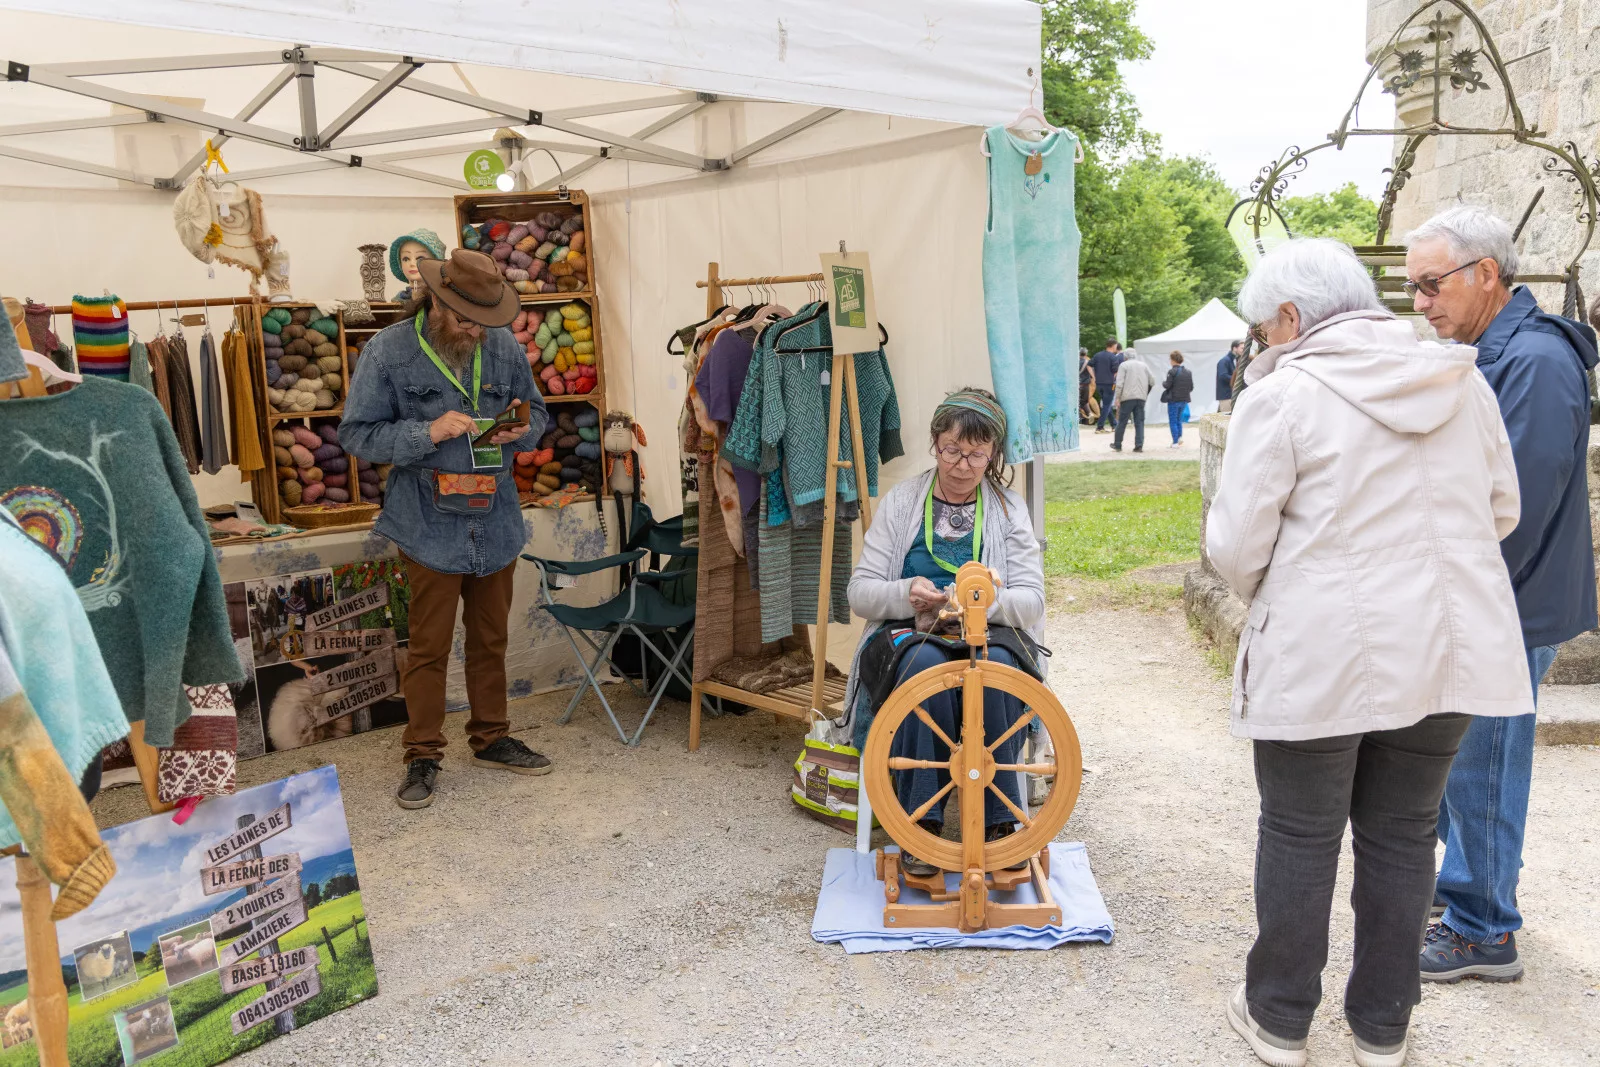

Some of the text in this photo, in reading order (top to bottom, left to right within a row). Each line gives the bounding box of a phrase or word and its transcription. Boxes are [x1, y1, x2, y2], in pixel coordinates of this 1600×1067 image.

[313, 591, 380, 626] LES LAINES DE
[314, 635, 382, 650] LA FERME DES
[327, 662, 377, 686] 2 YOURTES
[326, 681, 387, 717] 0641305260
[208, 813, 283, 862] LES LAINES DE
[212, 858, 289, 886] LA FERME DES
[226, 888, 285, 924] 2 YOURTES
[233, 913, 292, 956] LAMAZIERE
[232, 950, 305, 984] BASSE 19160
[238, 980, 310, 1027] 0641305260
